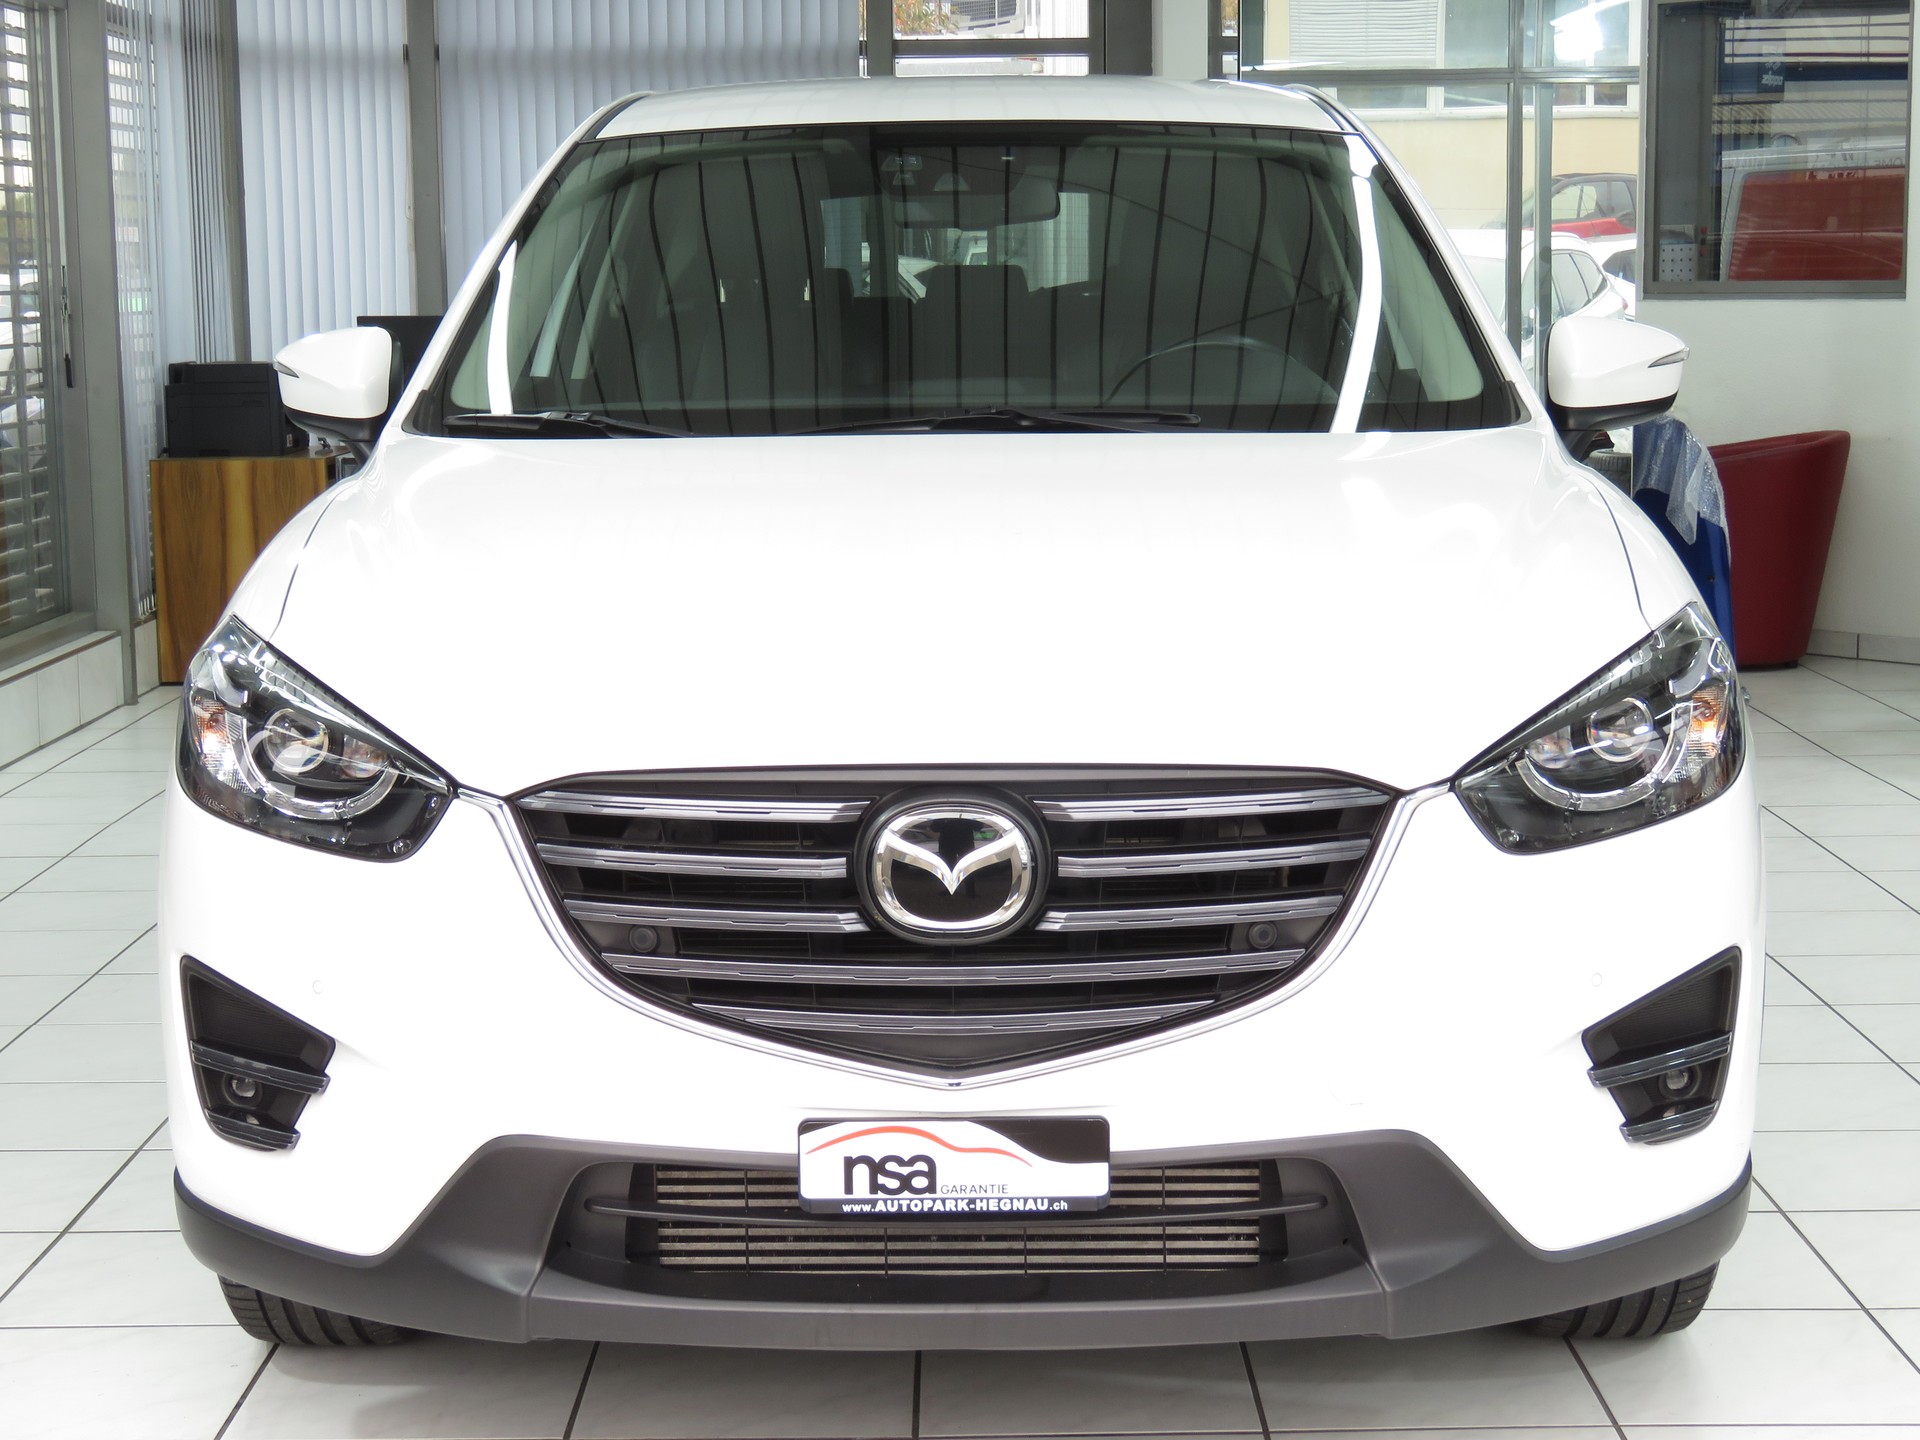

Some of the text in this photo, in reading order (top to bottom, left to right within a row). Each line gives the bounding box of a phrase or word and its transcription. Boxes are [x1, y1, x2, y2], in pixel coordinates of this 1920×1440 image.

[843, 1154, 937, 1196] nsa
[940, 1184, 1009, 1195] GARANTIE
[842, 1198, 1068, 1213] www.AUTOPARK-HEGNAU.ch
